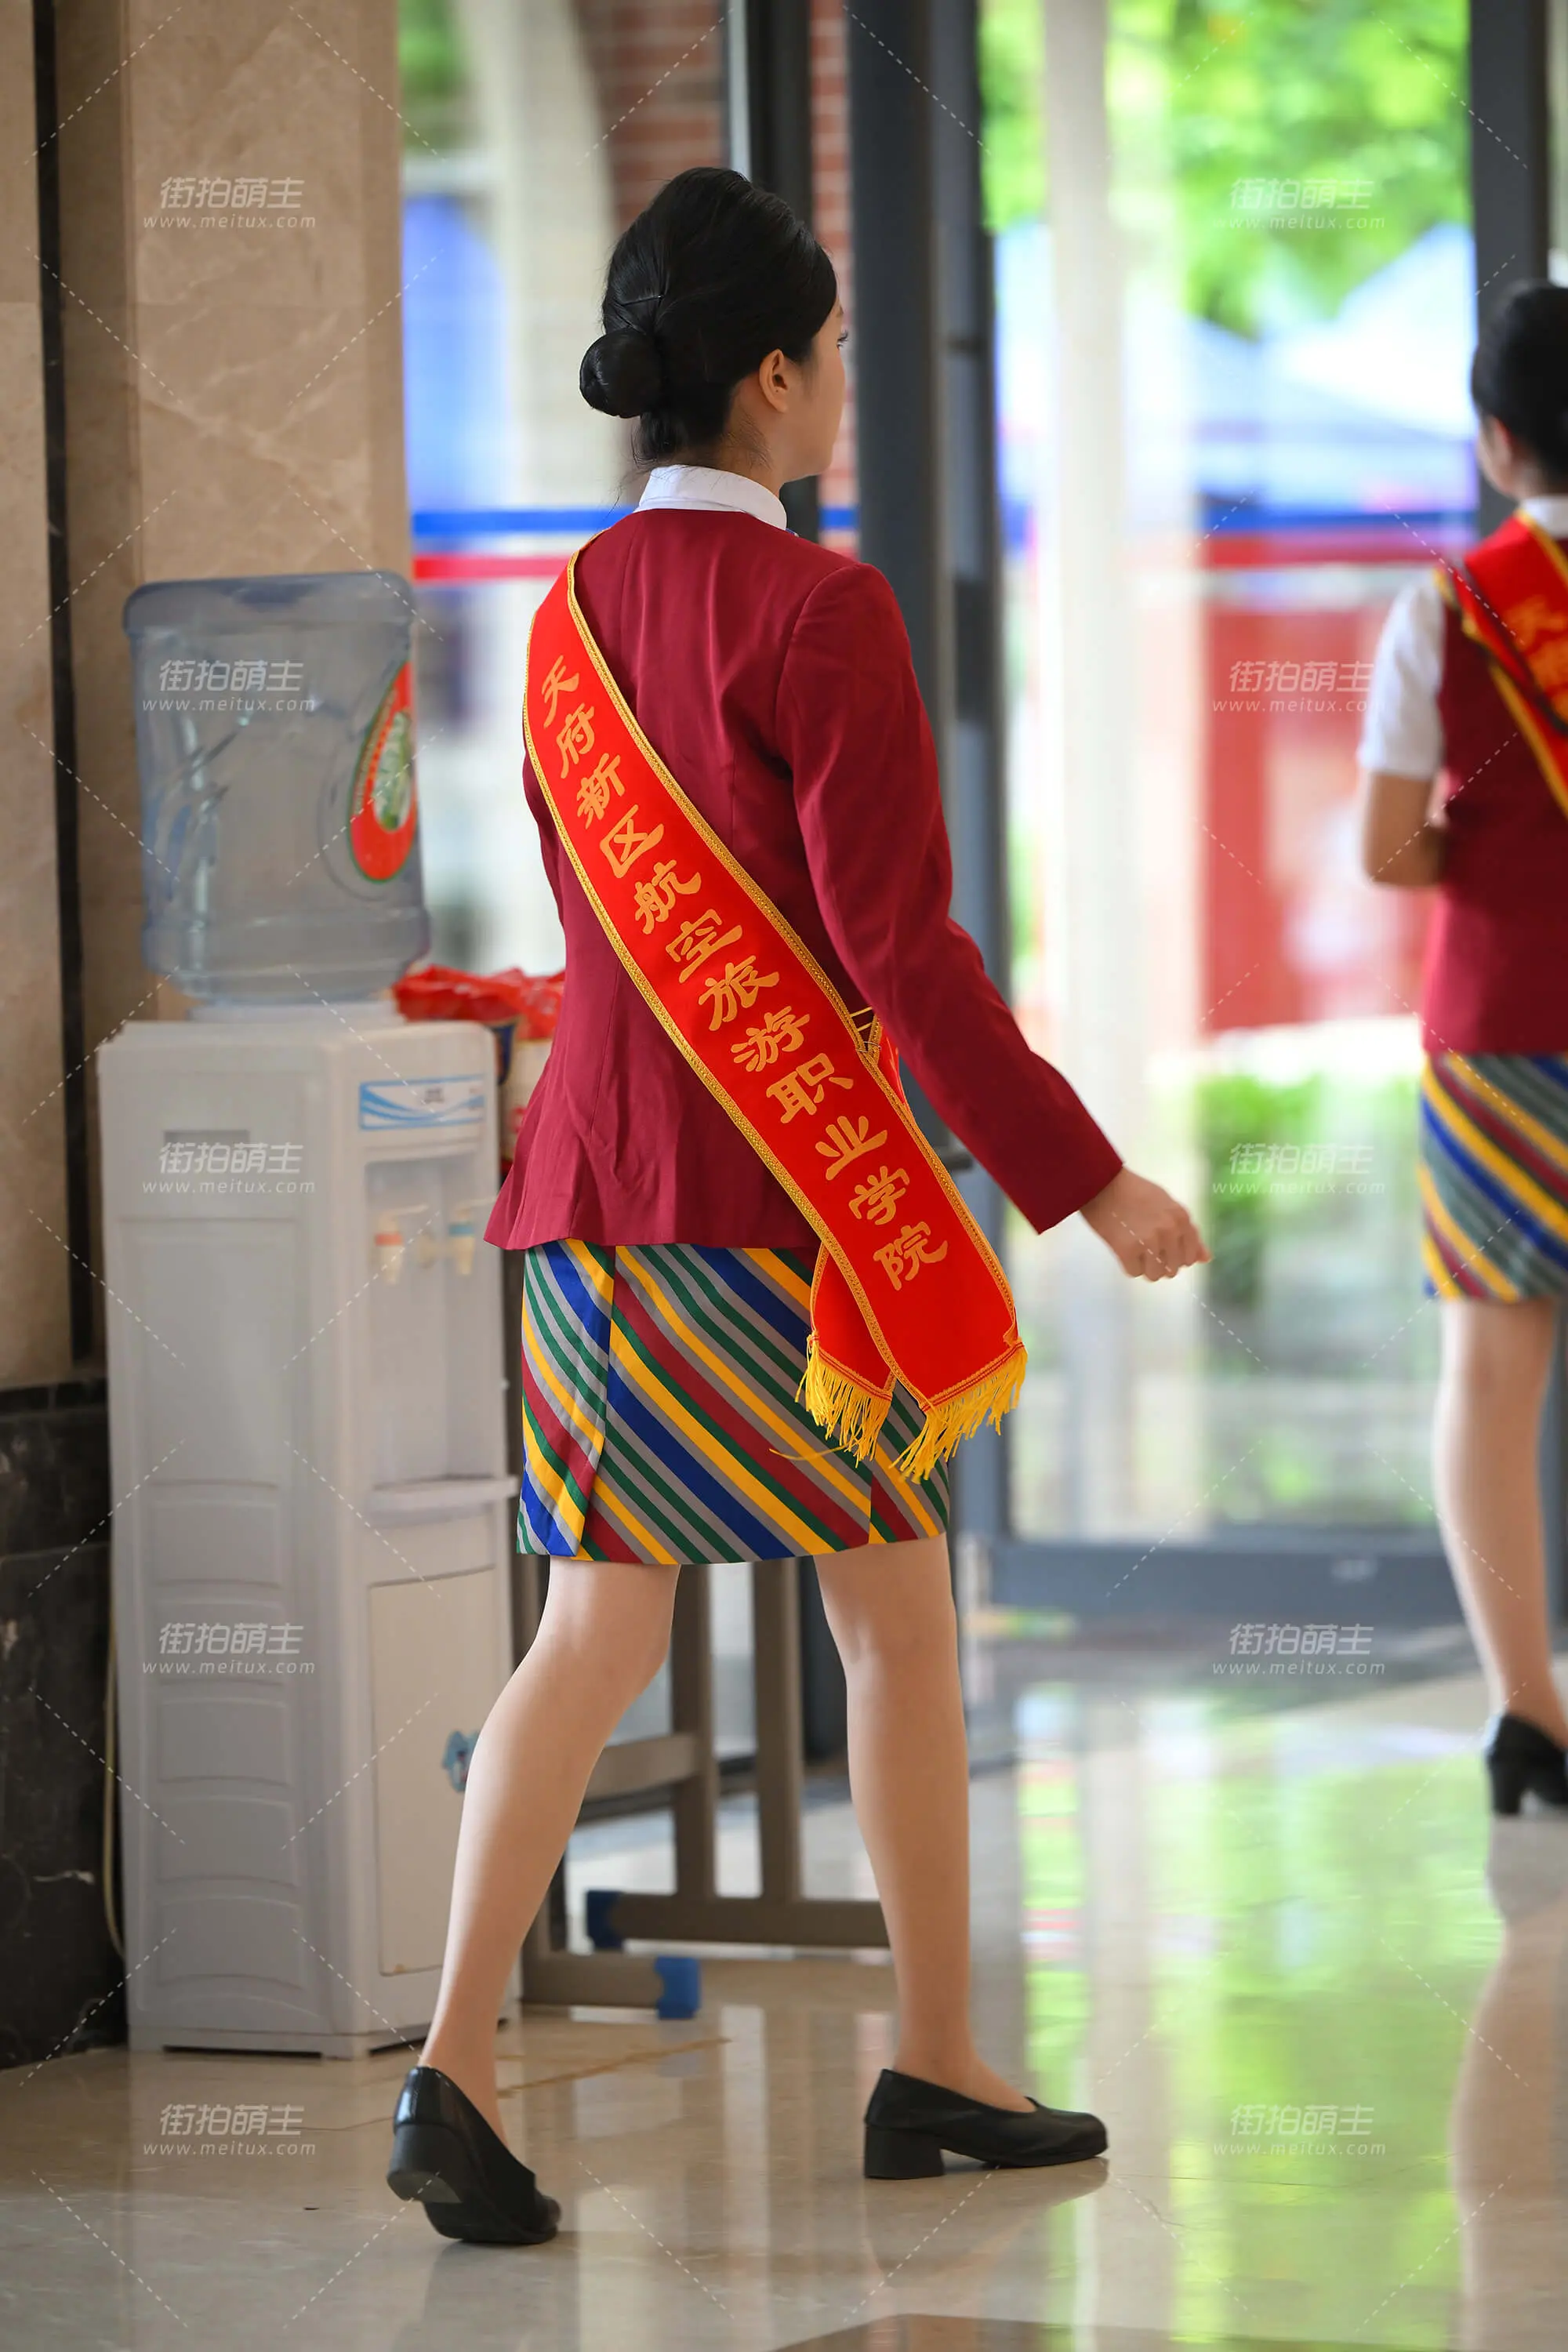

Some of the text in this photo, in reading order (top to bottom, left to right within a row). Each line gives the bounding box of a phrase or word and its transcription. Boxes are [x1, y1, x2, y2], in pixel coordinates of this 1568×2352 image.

[541, 654, 948, 1292] 天府新区航空旅游职业学院
